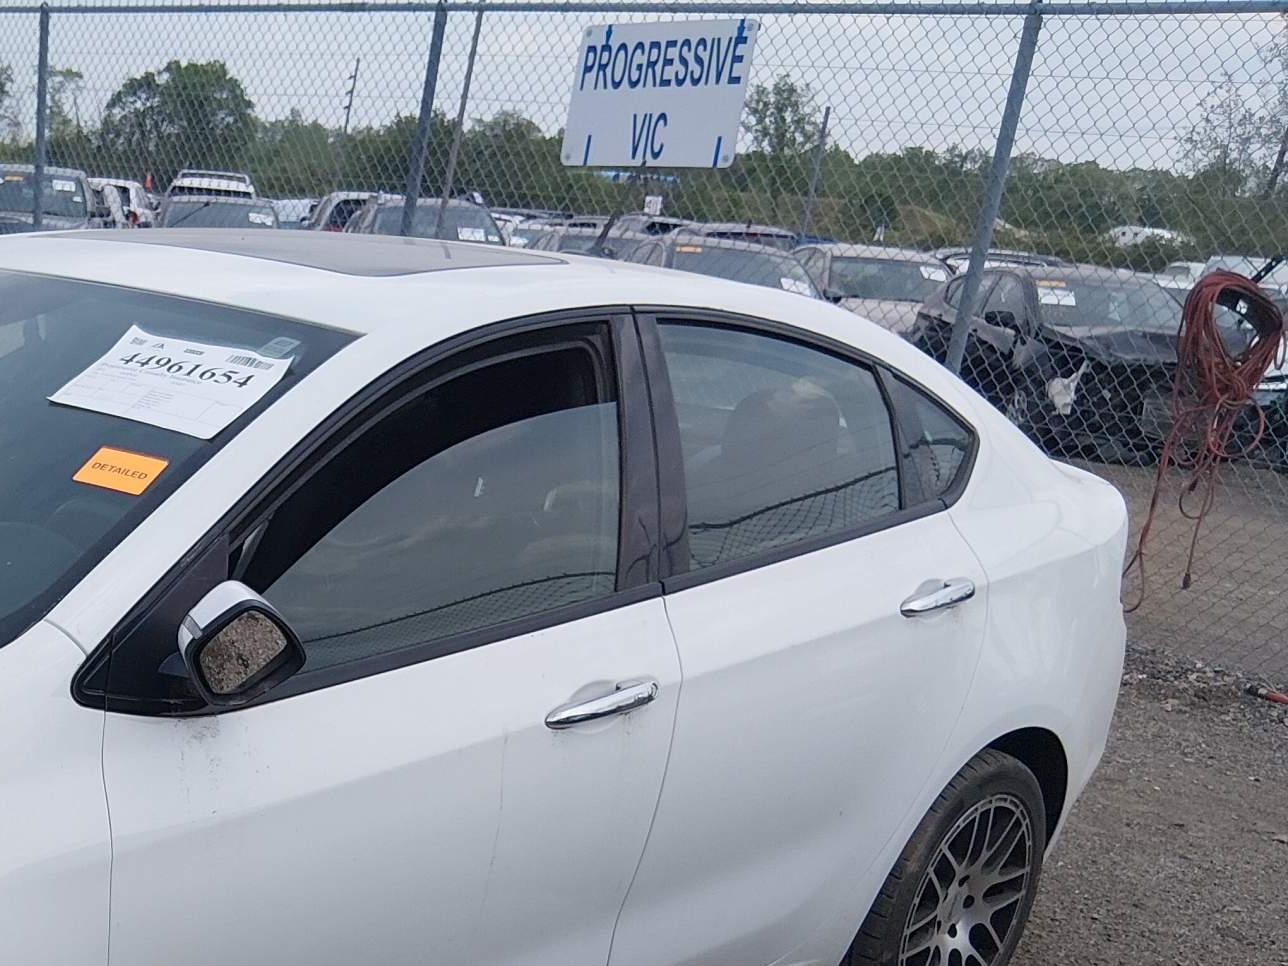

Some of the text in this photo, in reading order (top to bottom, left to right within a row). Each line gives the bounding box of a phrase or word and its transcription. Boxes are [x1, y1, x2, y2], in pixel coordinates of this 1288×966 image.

[579, 36, 748, 91] PROGRESSIVE
[631, 112, 668, 160] VIC
[119, 352, 256, 388] 44961654
[91, 461, 148, 480] DETAILED
